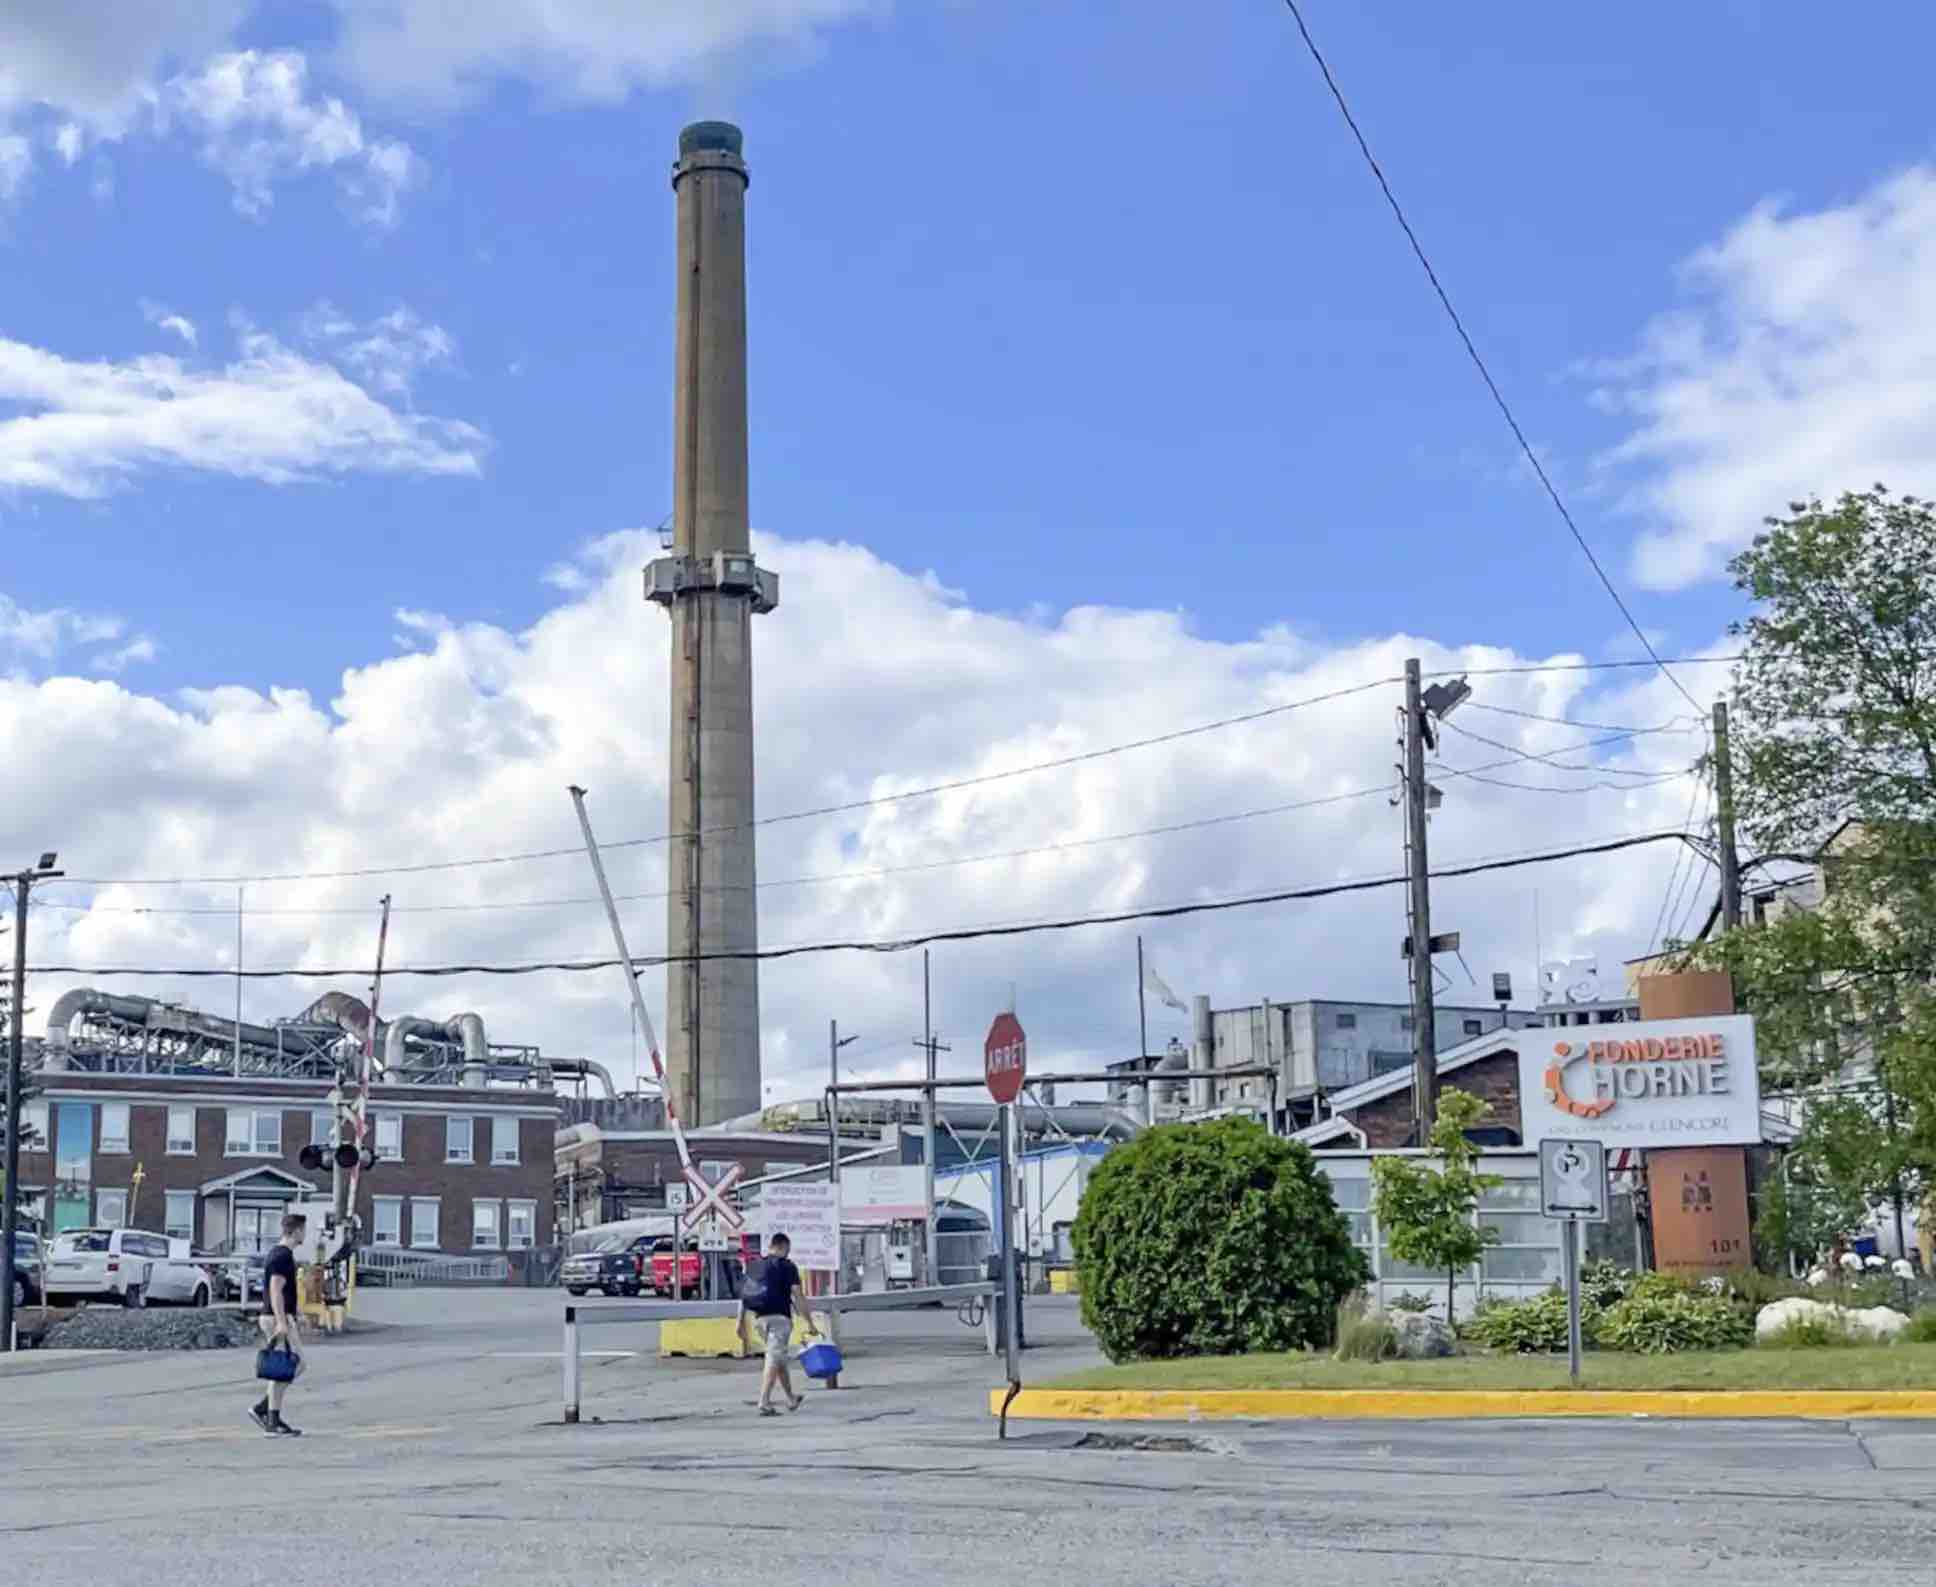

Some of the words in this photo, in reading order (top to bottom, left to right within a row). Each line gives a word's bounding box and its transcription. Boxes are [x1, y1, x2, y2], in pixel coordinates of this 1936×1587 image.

[988, 1036, 1025, 1074] ARRÊT
[1588, 1034, 1725, 1065] FONDERIE
[1592, 1061, 1730, 1099] HORNE
[1710, 1239, 1740, 1254] 101
